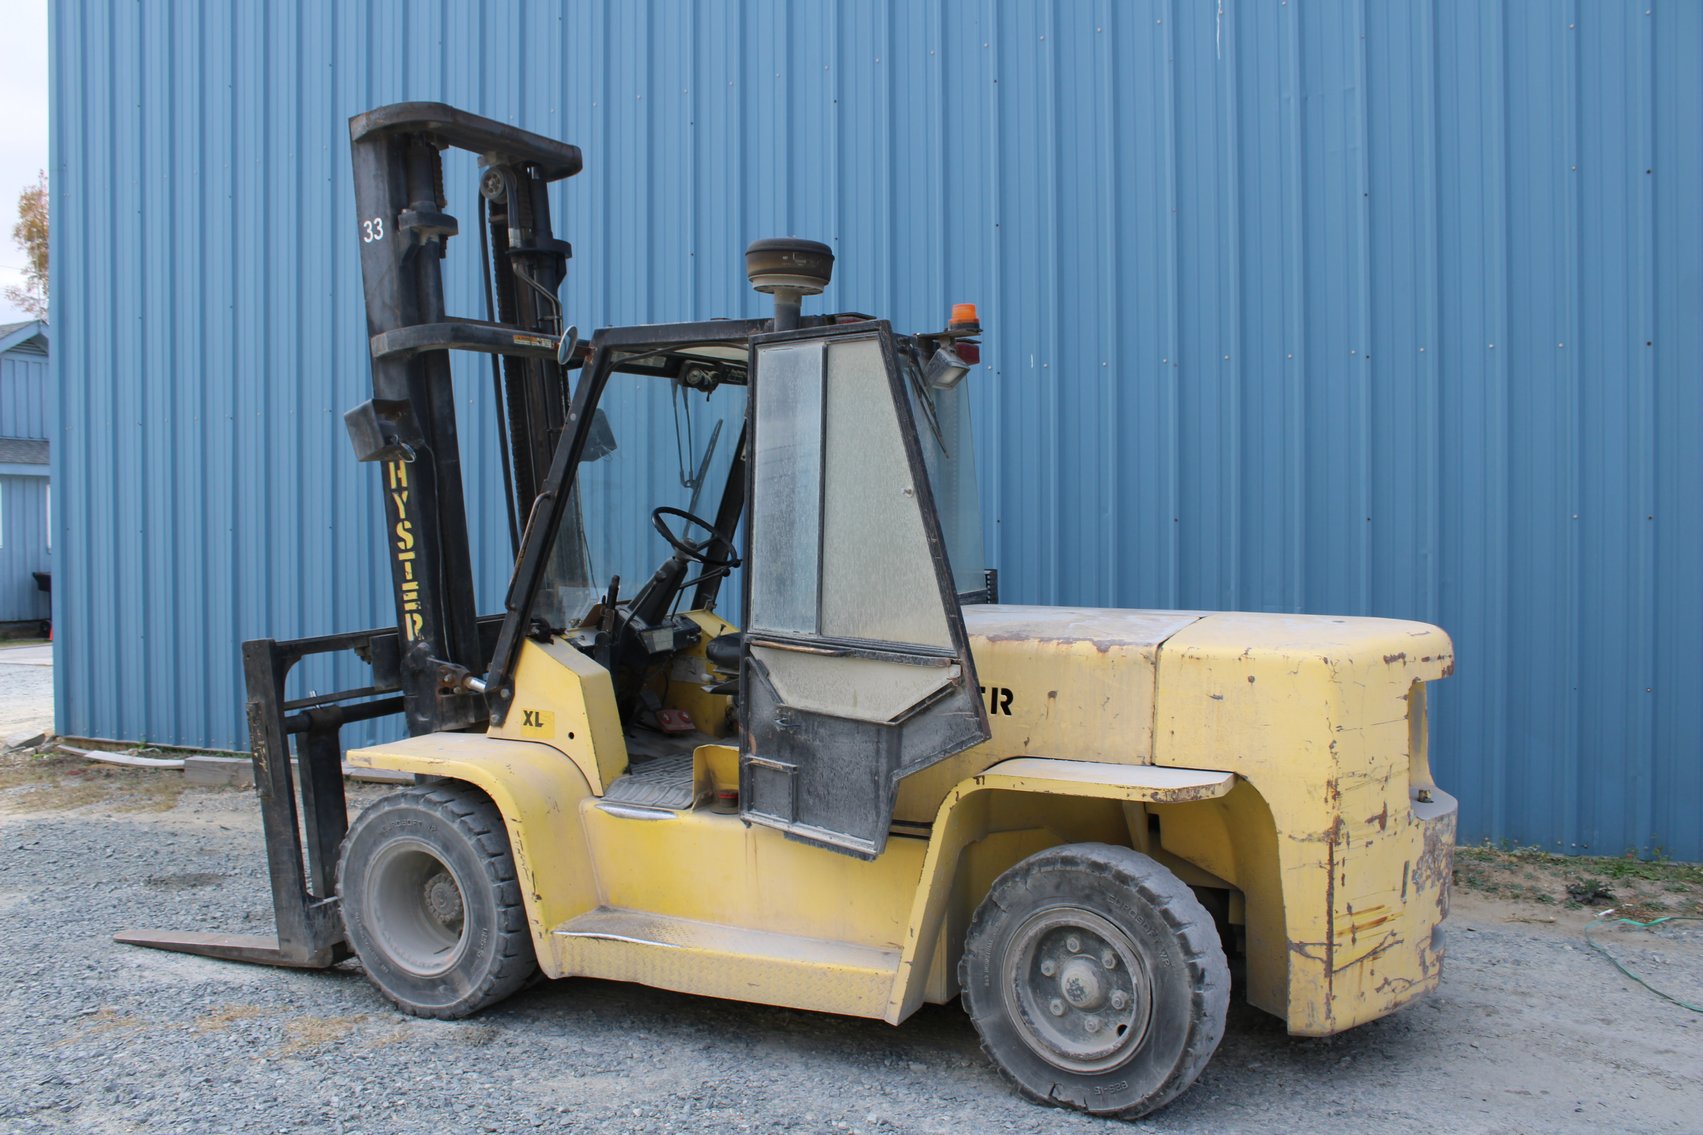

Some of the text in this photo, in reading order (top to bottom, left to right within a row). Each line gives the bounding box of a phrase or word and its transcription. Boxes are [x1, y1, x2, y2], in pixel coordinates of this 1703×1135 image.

[363, 217, 384, 243] 33
[388, 459, 425, 641] HYSTER
[523, 710, 544, 728] XL
